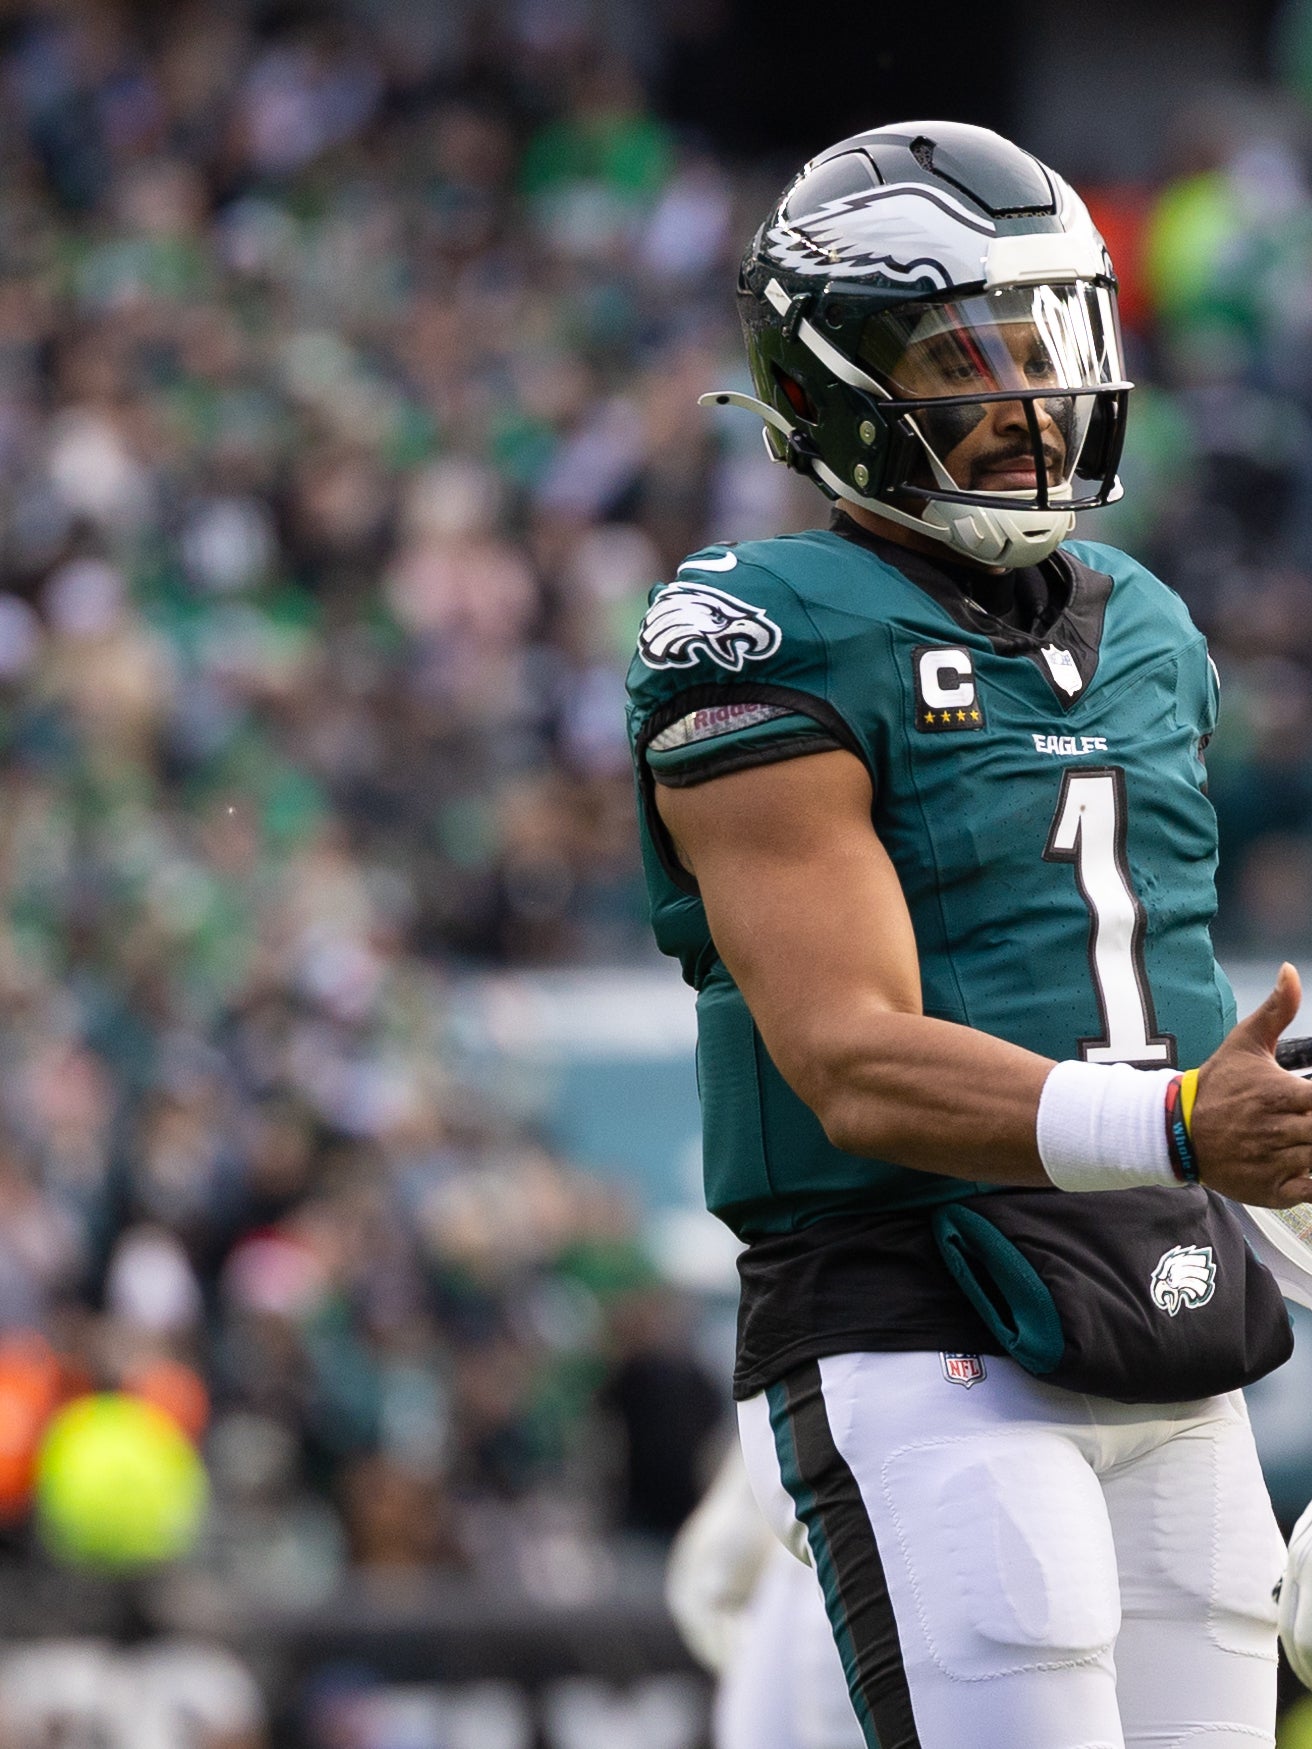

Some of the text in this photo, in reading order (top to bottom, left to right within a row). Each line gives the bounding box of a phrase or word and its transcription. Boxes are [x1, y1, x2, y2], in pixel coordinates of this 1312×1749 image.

[919, 649, 975, 709] C
[1032, 734, 1108, 756] EAGLES
[1043, 766, 1177, 1068] 1
[948, 1360, 979, 1377] NFL
